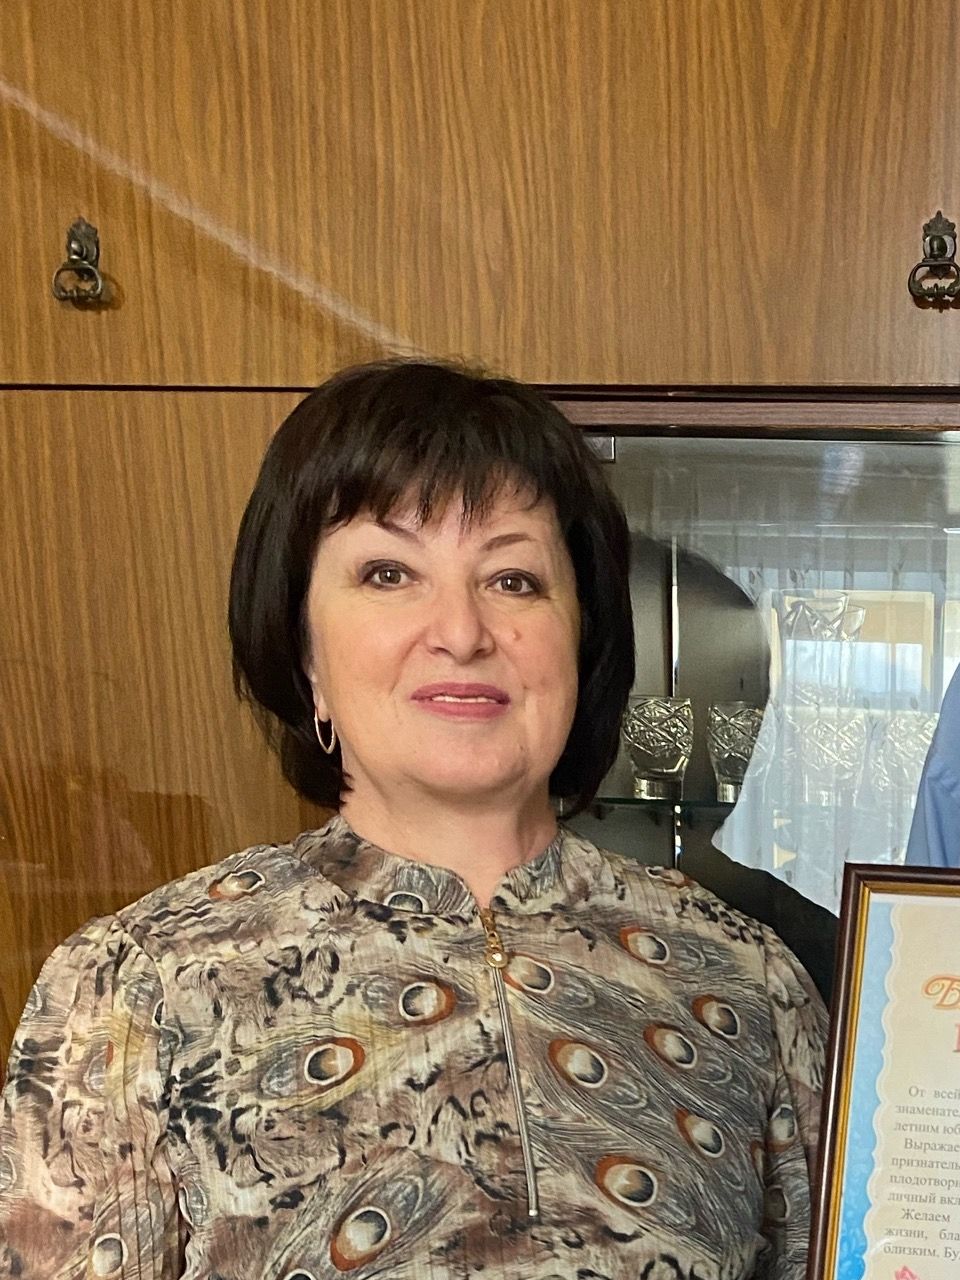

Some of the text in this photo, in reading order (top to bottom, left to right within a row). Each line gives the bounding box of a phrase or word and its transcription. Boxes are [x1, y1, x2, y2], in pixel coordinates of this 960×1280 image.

[908, 1085, 926, 1098] От
[934, 1088, 960, 1100] всей
[894, 1122, 939, 1134] летним
[888, 1191, 936, 1204] личный
[901, 1208, 950, 1222] Желаем
[884, 1227, 928, 1240] жизни,
[883, 1242, 940, 1258] близким.
